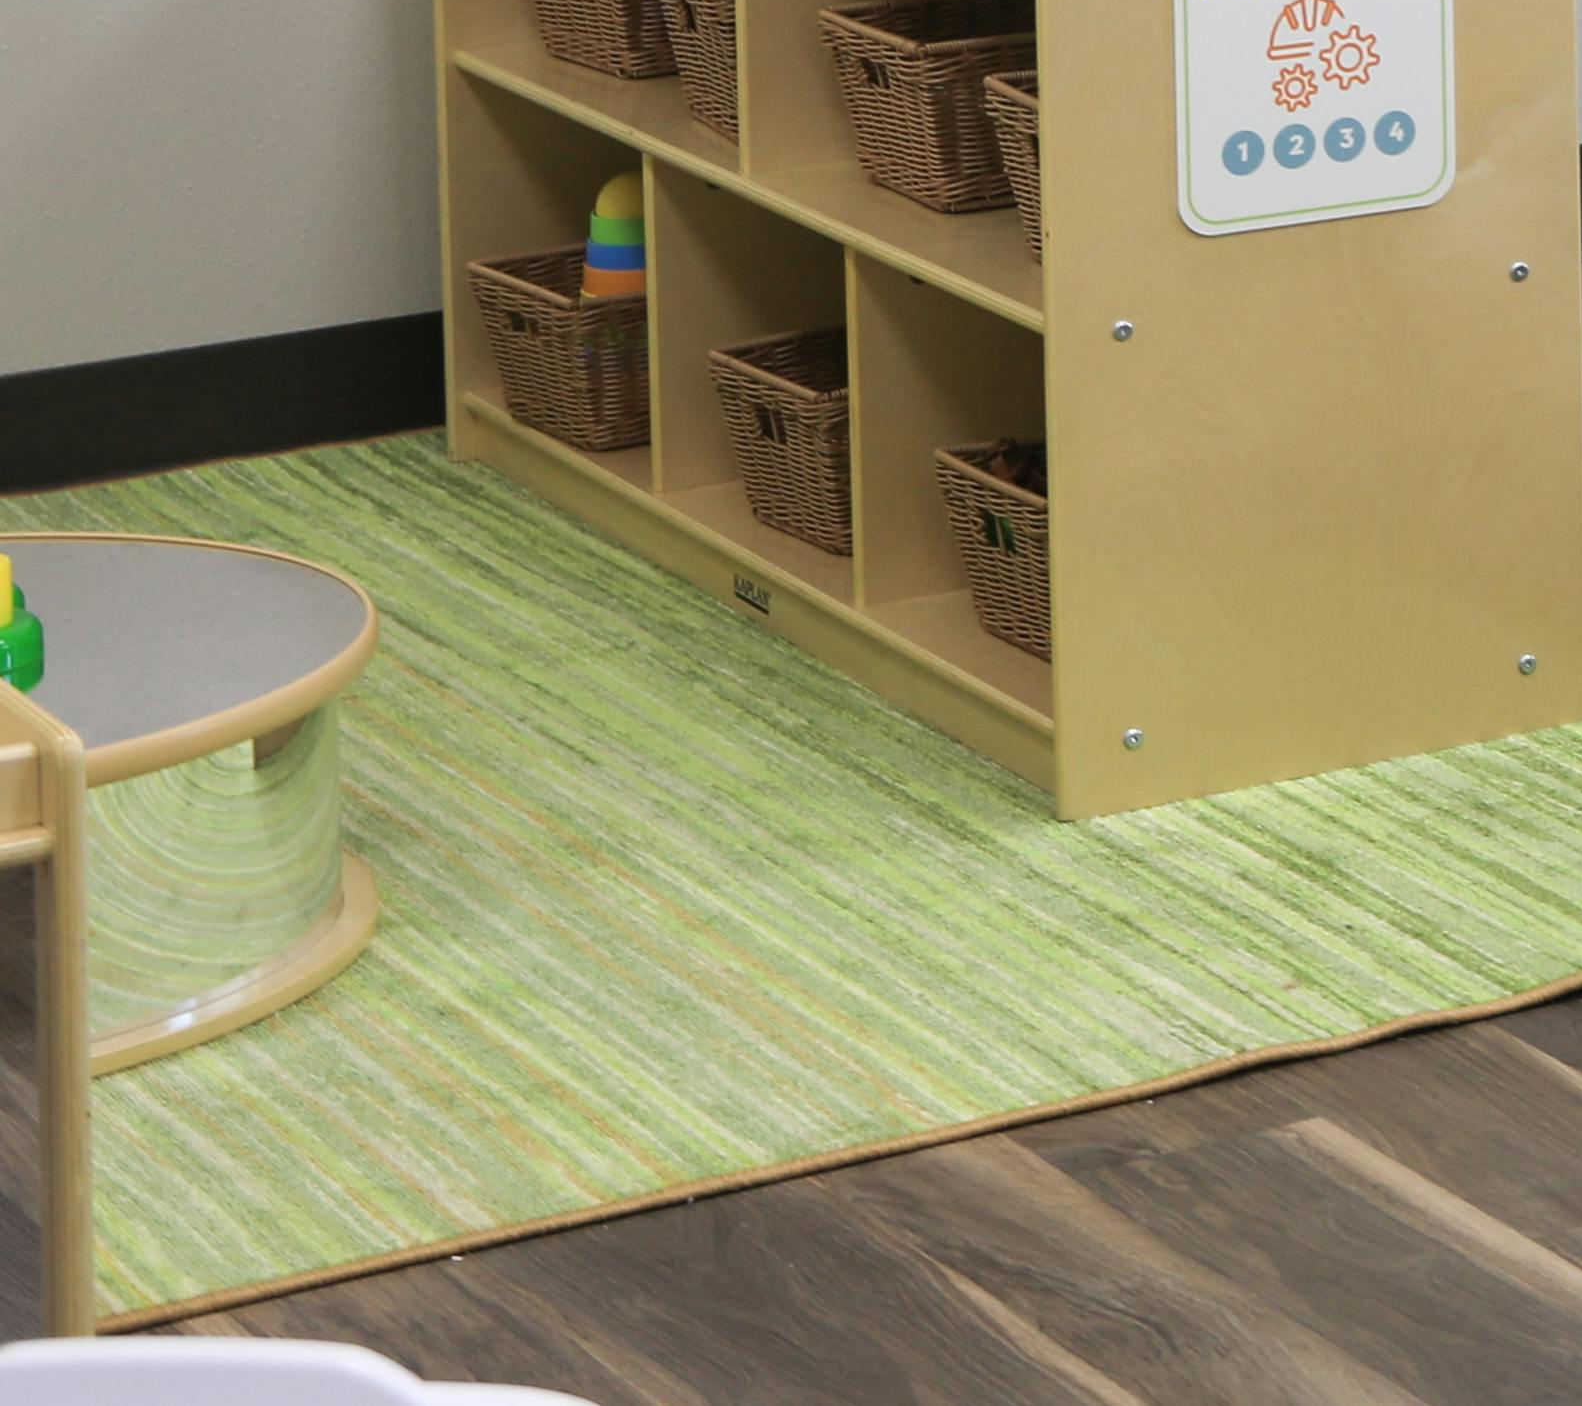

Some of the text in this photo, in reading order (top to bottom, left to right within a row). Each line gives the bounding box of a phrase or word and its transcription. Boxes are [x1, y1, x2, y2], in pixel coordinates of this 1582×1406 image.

[1237, 121, 1405, 162] 1 2 3 4
